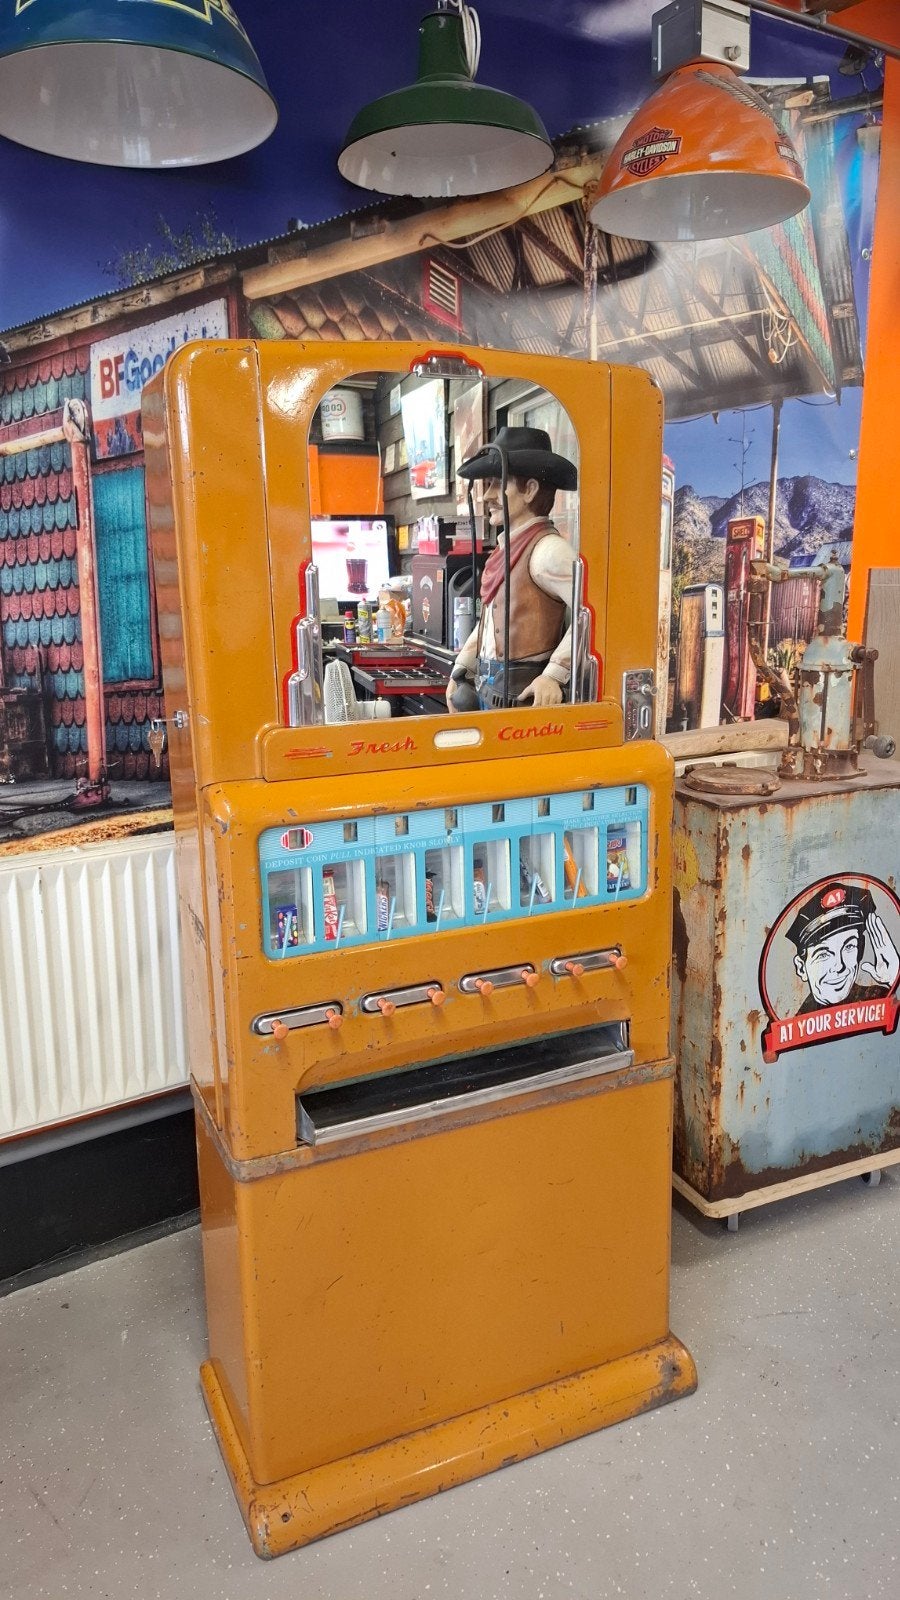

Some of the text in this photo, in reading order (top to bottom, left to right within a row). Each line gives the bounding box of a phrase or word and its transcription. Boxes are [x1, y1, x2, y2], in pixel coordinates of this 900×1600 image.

[623, 140, 677, 165] HARLEY-DAVIDSON
[631, 156, 661, 172] CYCLES
[347, 722, 564, 756] Fresh Candy
[265, 857, 304, 869] DEPOSIT
[307, 854, 327, 863] COIN
[330, 850, 352, 860] PULL
[403, 839, 427, 850] KNOB
[827, 891, 842, 905] A1
[780, 1003, 886, 1043] AT YOUR SERVICE!
